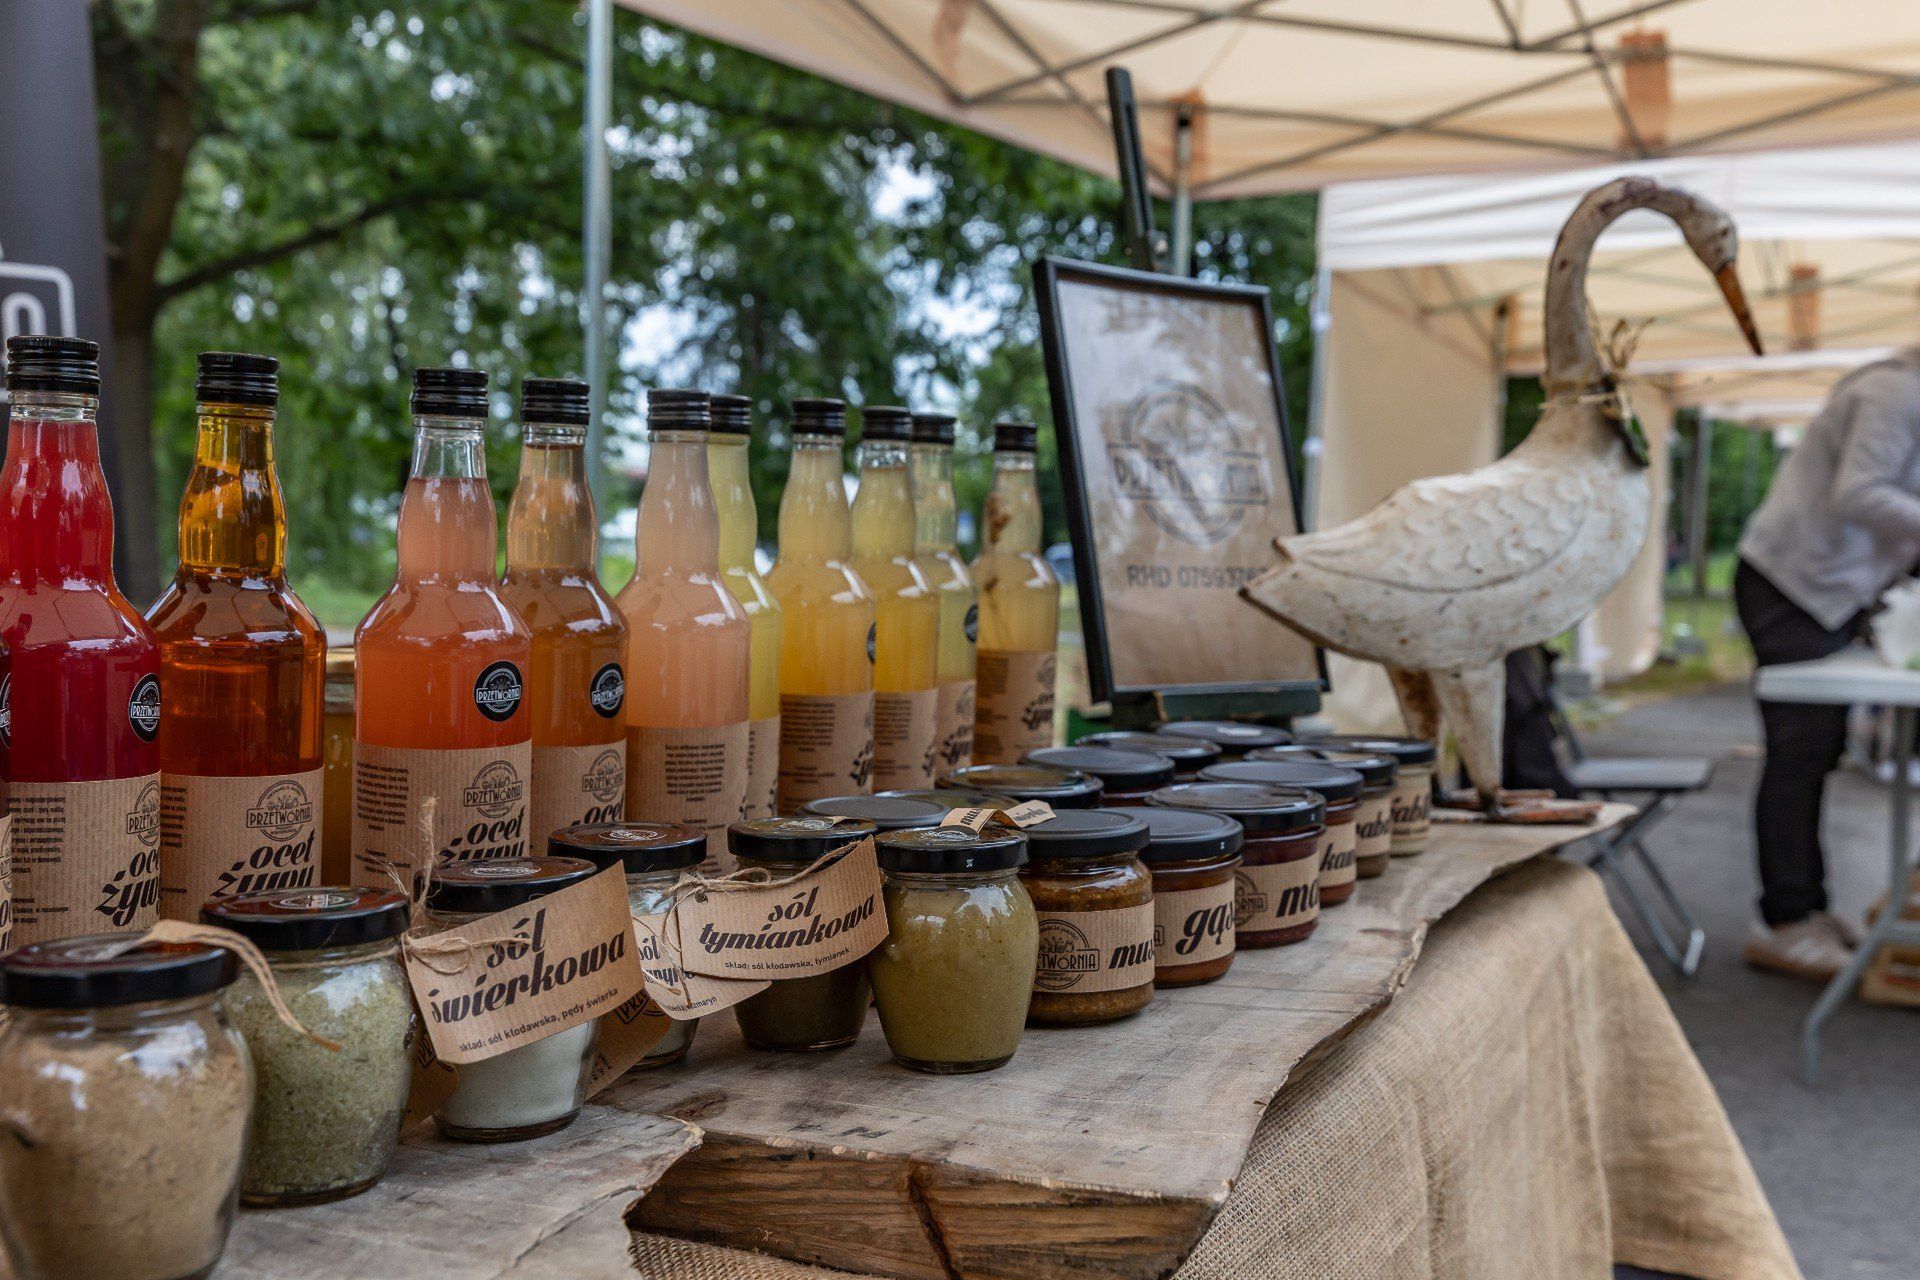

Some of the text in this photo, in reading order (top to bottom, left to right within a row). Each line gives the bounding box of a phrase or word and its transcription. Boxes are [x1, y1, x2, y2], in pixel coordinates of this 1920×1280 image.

[1127, 564, 1171, 588] RHD
[466, 785, 520, 804] PRZETWÓRNIA
[250, 806, 310, 826] PRZETWÓRNIA
[467, 805, 525, 844] ocet
[250, 828, 316, 869] ocet
[94, 870, 161, 926] żyw
[767, 885, 820, 923] sól
[486, 907, 547, 969] sól
[699, 893, 876, 955] tymiankowa
[428, 930, 627, 1024] świerkowa
[751, 961, 764, 970] sól
[766, 959, 814, 970] kłodawska,
[815, 946, 851, 966] tymianek
[460, 1039, 486, 1052] skład:
[488, 1033, 503, 1045] sól
[504, 1013, 561, 1040] kłodawska,
[561, 1003, 585, 1021] pędy
[586, 988, 619, 1009] świerka
